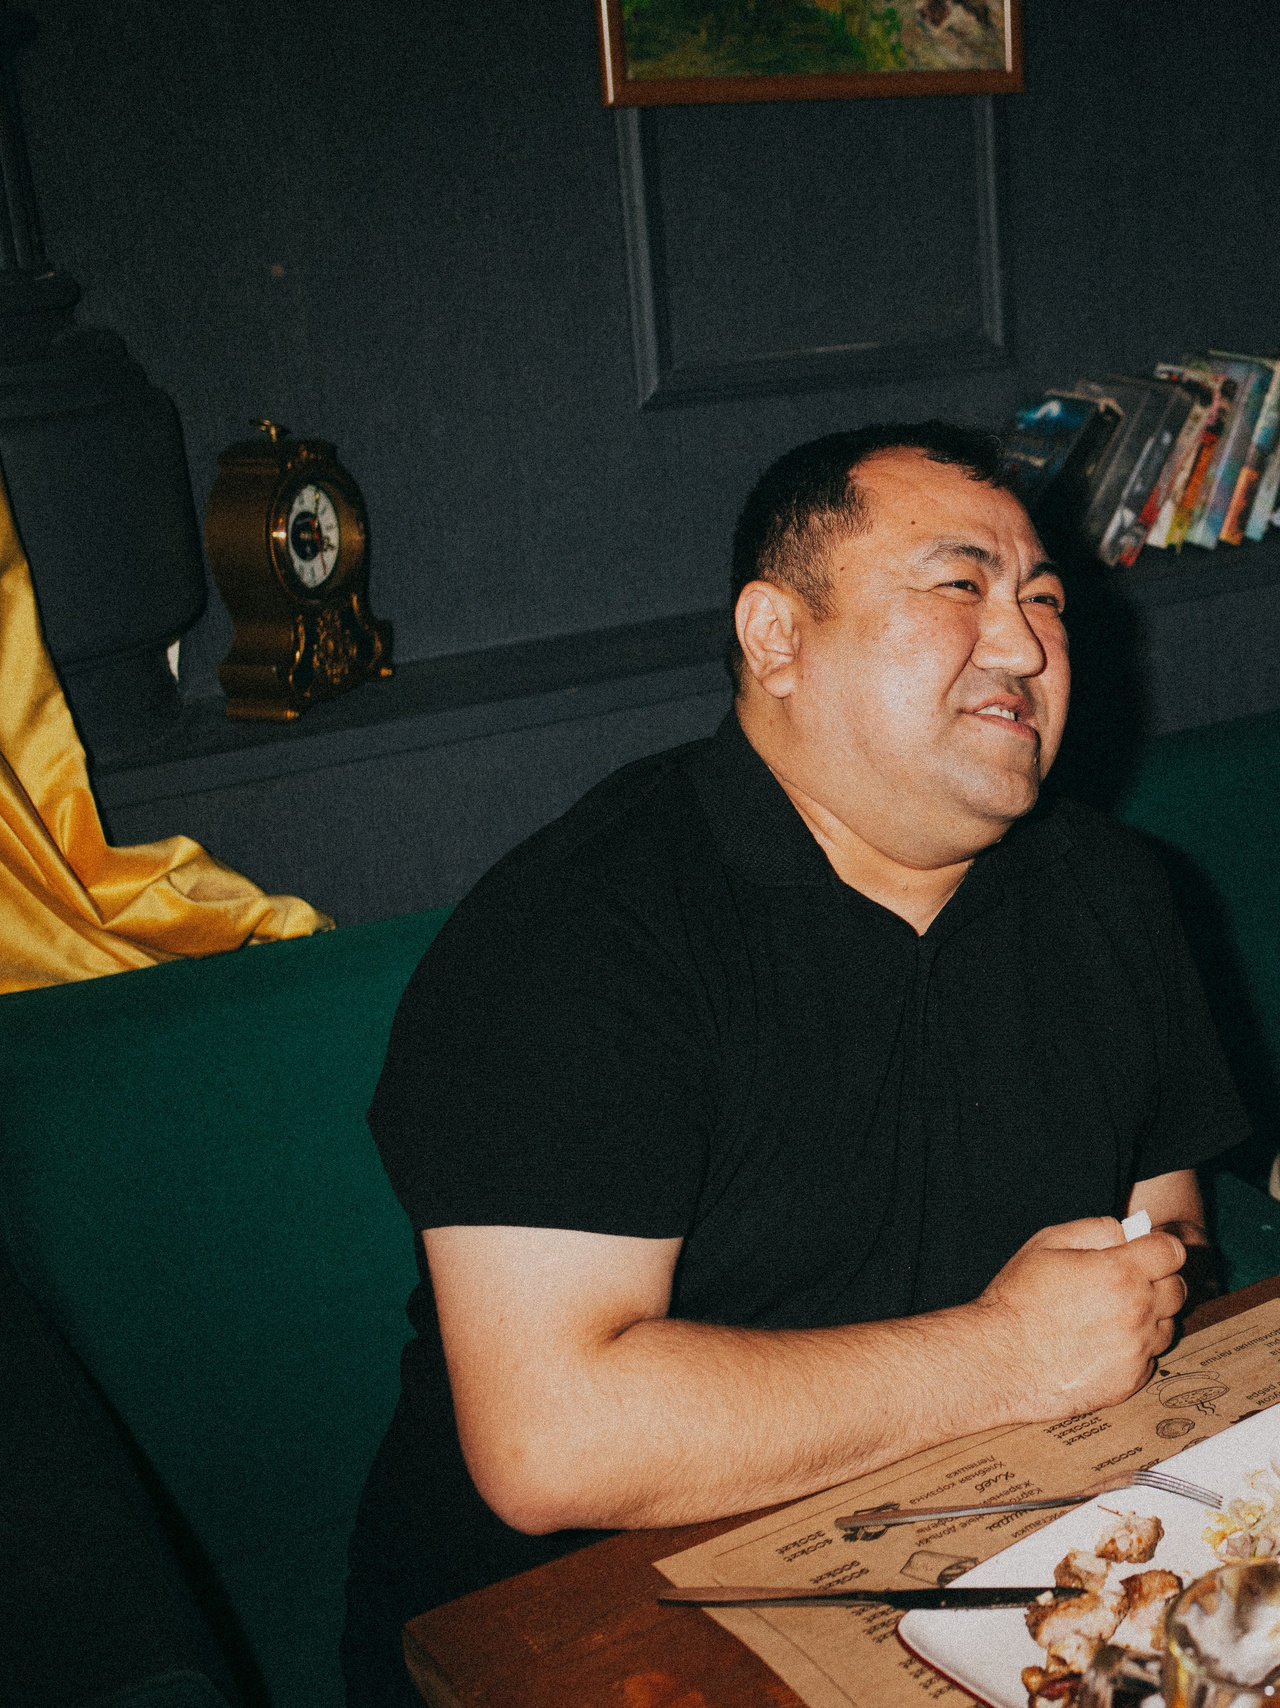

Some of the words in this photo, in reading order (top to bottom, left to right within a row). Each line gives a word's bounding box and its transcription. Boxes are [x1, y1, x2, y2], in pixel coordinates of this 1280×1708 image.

[1199, 1349, 1233, 1367] лапша
[1054, 1416, 1103, 1439] 1700kzt
[1062, 1422, 1112, 1446] 1700kzt
[945, 1455, 996, 1479] Лепешка
[959, 1461, 1007, 1485] Хлебная
[909, 1482, 957, 1505] корзина
[974, 1471, 1016, 1493] Хлеб
[915, 1526, 957, 1547] дольки
